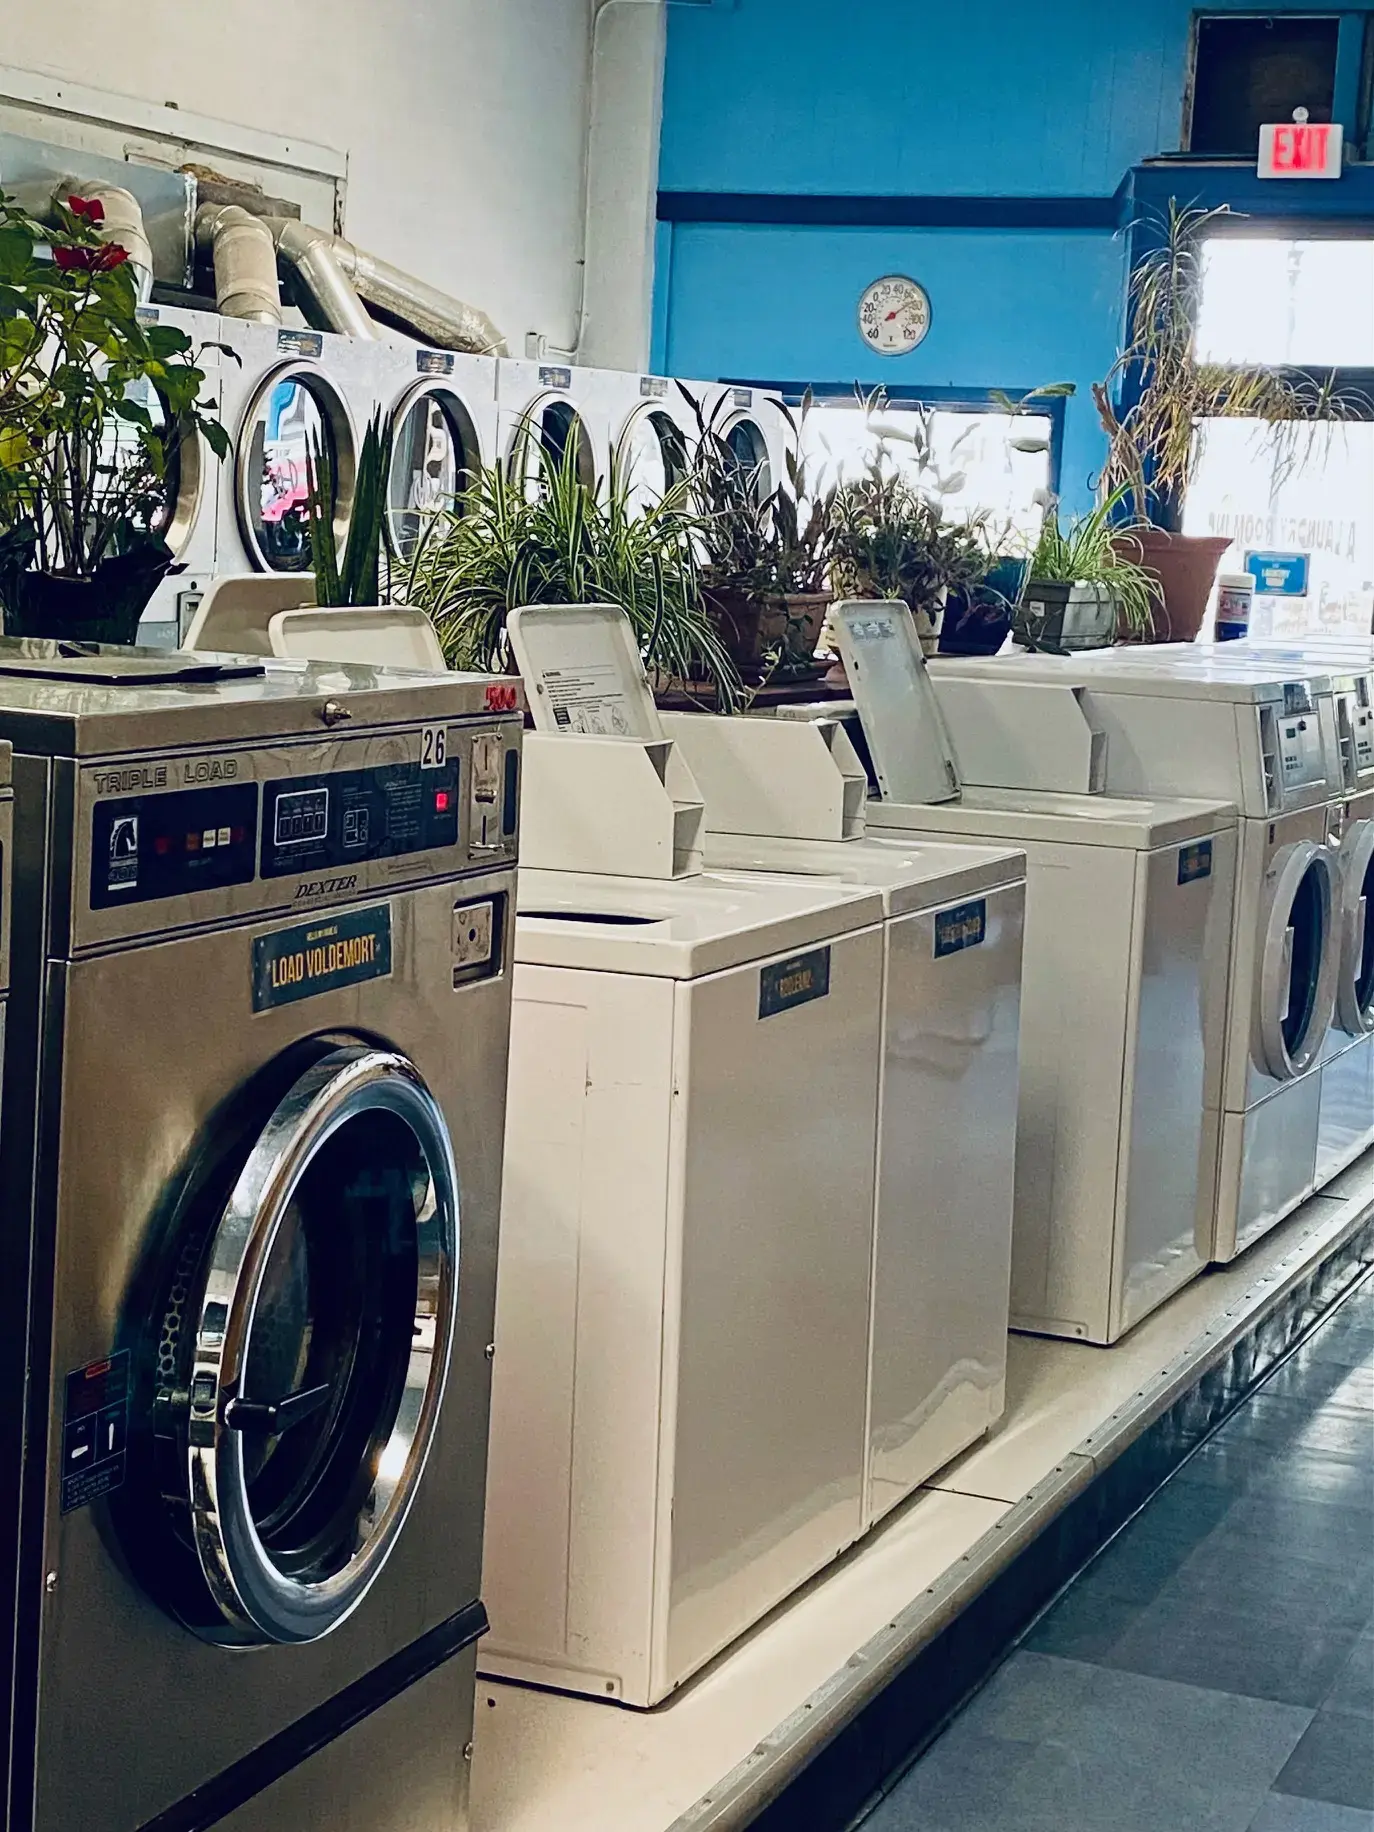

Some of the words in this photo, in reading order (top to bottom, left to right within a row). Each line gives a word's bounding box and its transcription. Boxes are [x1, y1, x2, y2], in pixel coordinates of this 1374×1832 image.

[1273, 127, 1329, 171] EXIT
[873, 292, 879, 301] 0
[423, 729, 445, 765] 26
[94, 766, 167, 794] TRIPLE
[183, 759, 237, 784] LOAD
[294, 874, 357, 898] DEXTER
[272, 953, 304, 988] LOAD
[306, 934, 376, 978] VOLDEMORT
